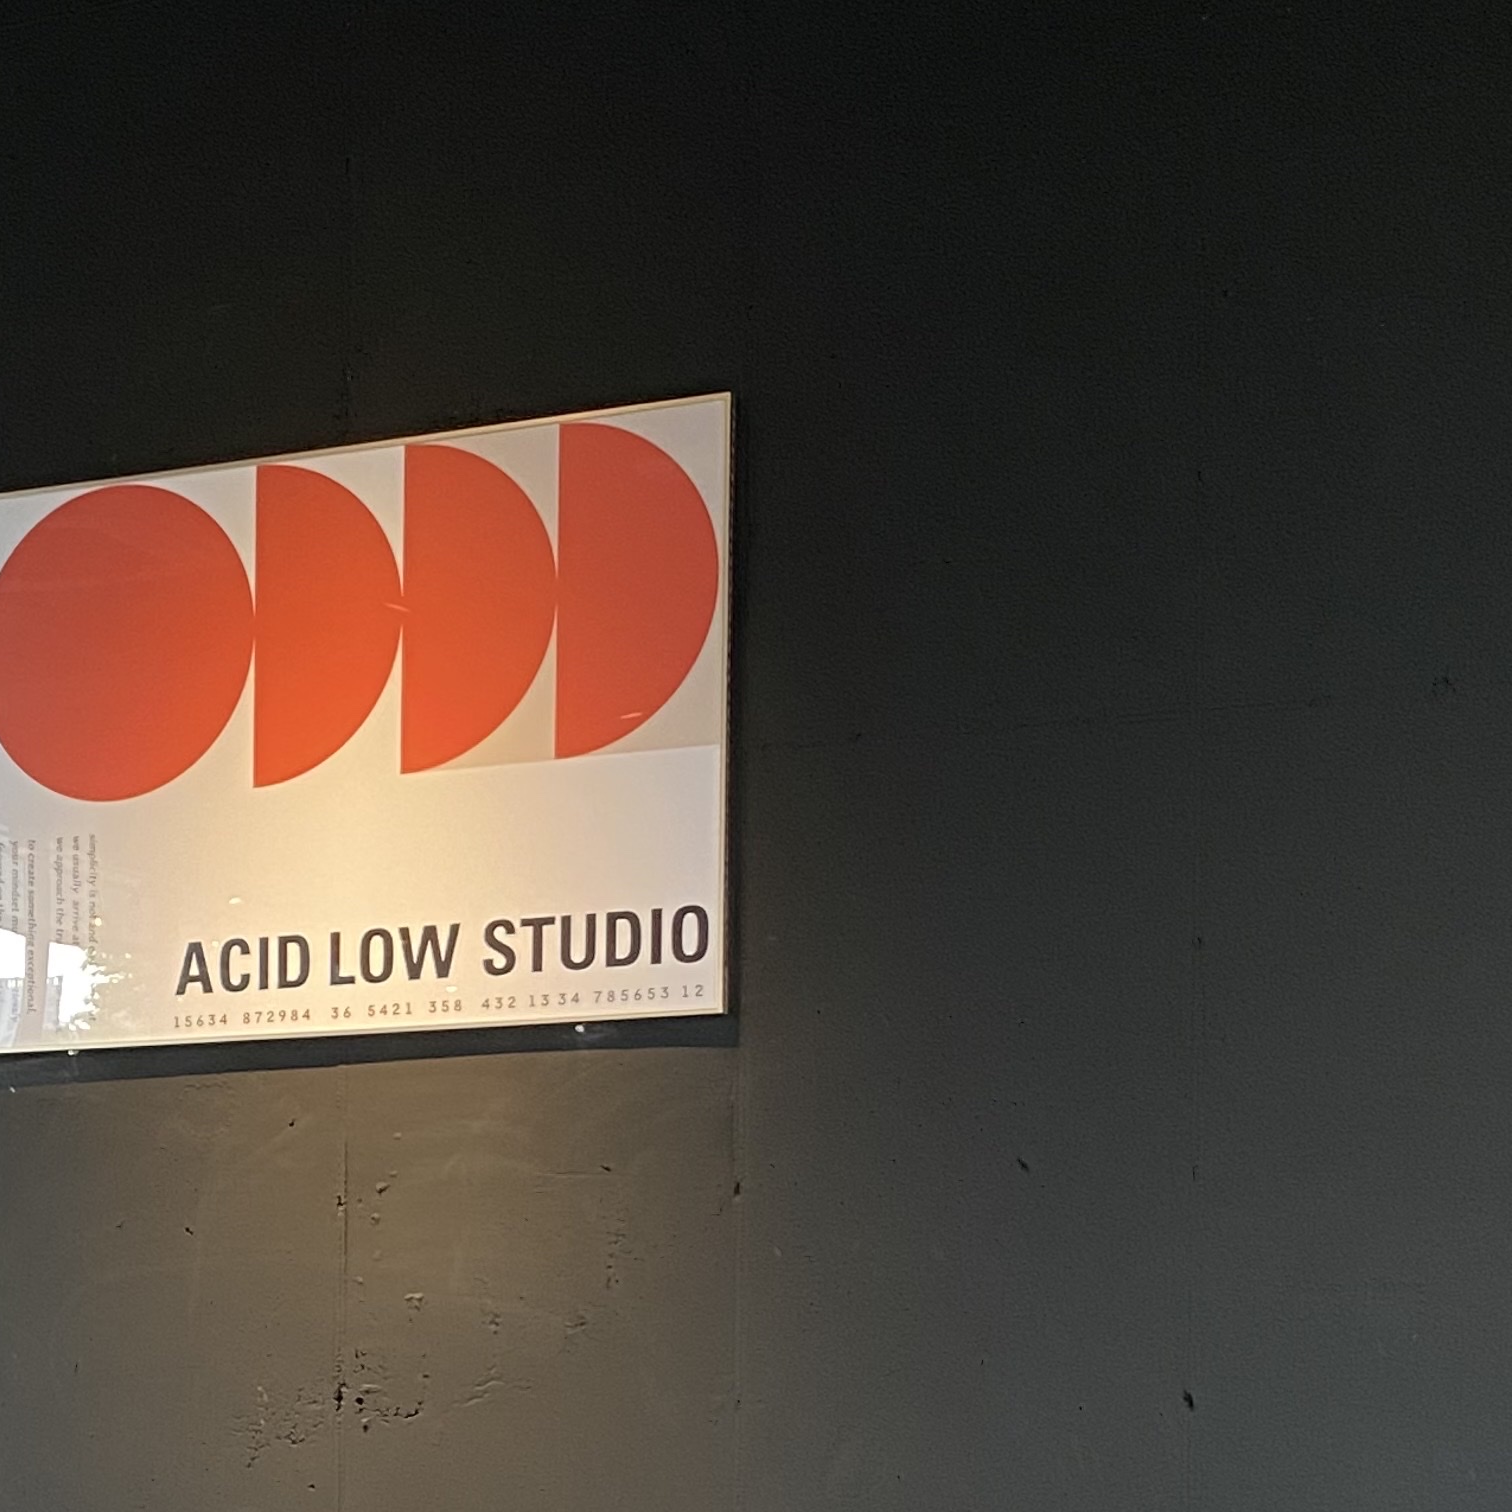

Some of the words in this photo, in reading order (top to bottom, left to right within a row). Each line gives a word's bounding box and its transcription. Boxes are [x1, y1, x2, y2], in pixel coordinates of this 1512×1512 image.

[9, 840, 19, 866] your
[28, 839, 37, 851] to
[56, 837, 65, 852] we
[71, 835, 80, 850] we
[87, 833, 99, 887] simplicity
[27, 852, 36, 887] create
[53, 854, 66, 905] approach
[70, 853, 82, 893] usually
[25, 889, 38, 947] something
[174, 936, 311, 996] ACID
[329, 922, 461, 987] LOW
[482, 904, 710, 977] STUDIO
[173, 1013, 228, 1029] 15634
[242, 1008, 311, 1025] 872984
[330, 1005, 352, 1020] 36
[367, 1001, 413, 1018] 5421
[428, 998, 463, 1014] 358
[480, 995, 517, 1011] 432
[593, 986, 670, 1004] 785653
[681, 983, 705, 999] 12
